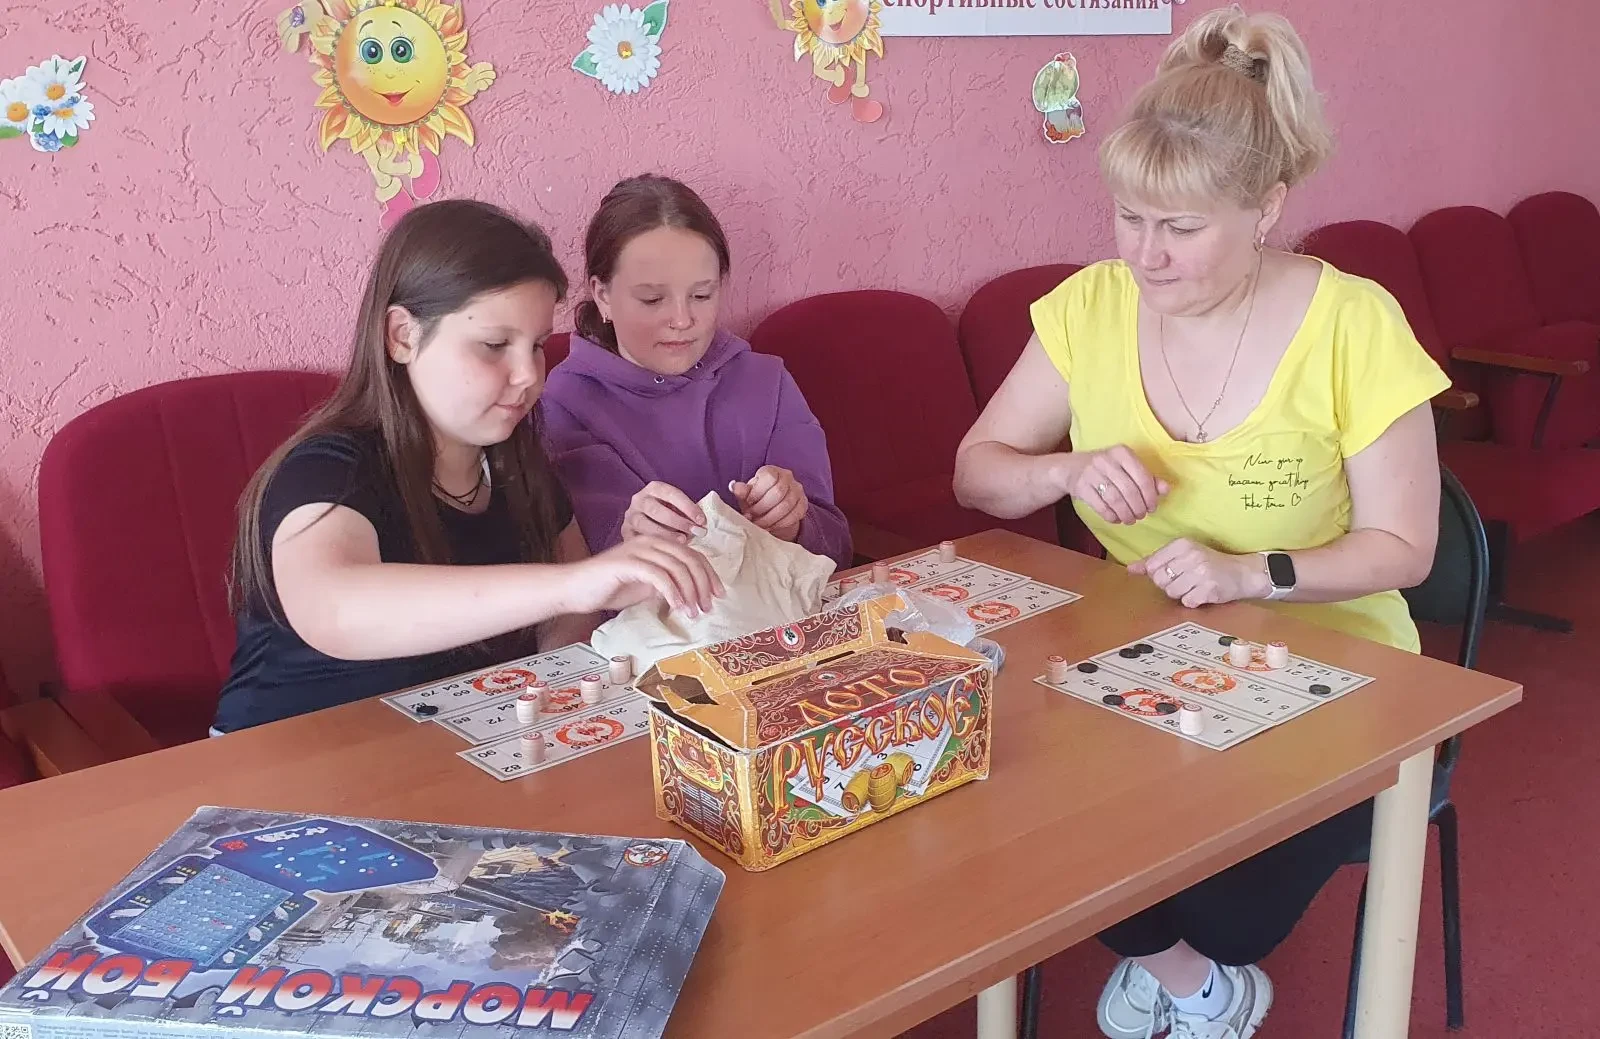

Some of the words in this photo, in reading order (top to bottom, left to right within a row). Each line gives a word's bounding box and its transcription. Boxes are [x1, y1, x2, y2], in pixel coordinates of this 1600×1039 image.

[790, 668, 927, 727] ЛОТО
[478, 750, 496, 758] 90
[20, 951, 197, 1003] БОЙ
[215, 966, 598, 1031] МОРСКОЙ
